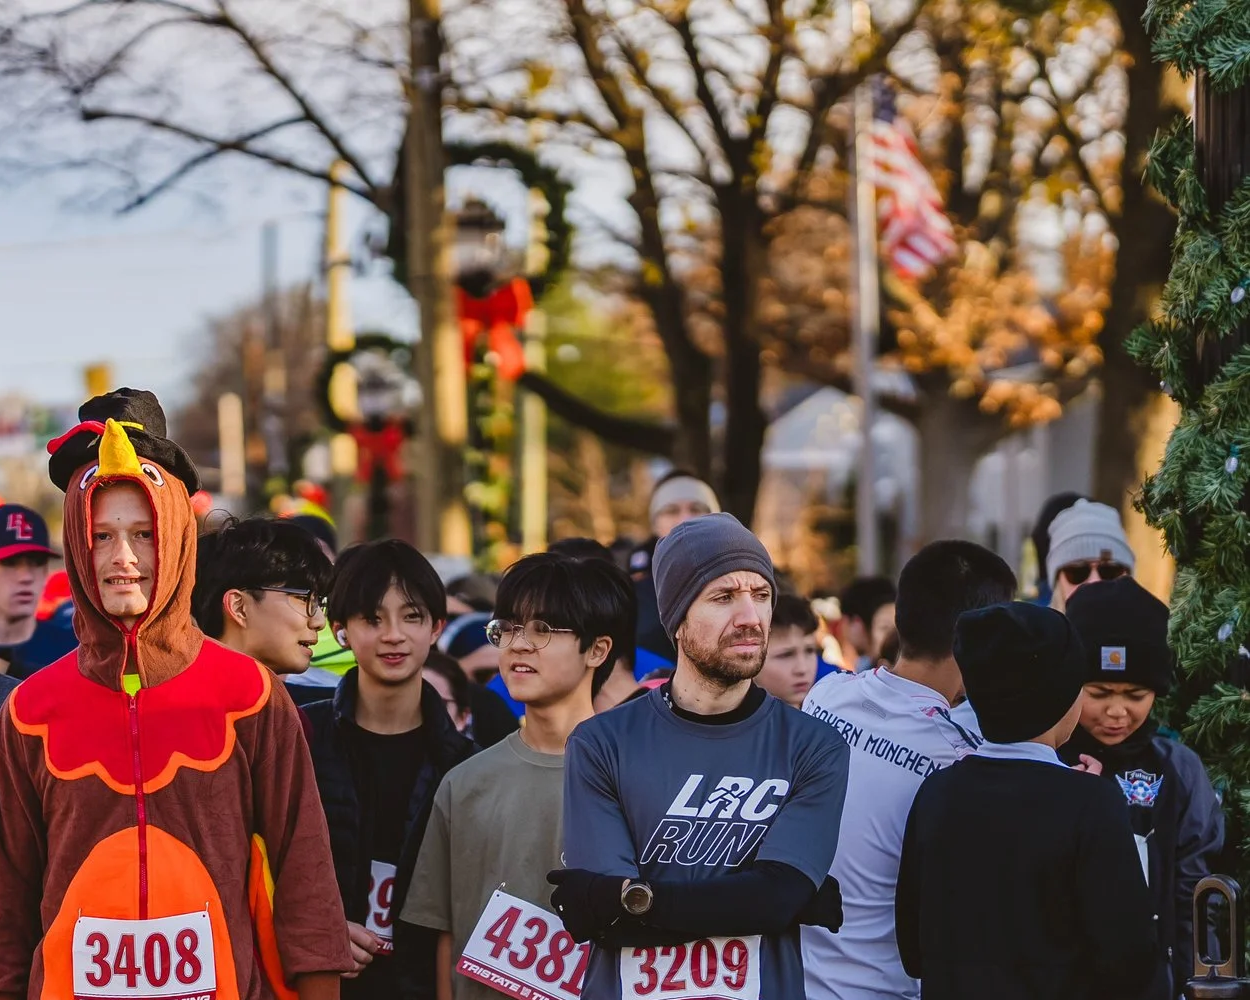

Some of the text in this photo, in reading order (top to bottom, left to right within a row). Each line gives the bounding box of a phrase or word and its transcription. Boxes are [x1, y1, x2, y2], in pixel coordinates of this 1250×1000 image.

[864, 734, 941, 778] MÜNCHEN
[665, 774, 789, 821] LRC
[640, 819, 768, 867] RUN
[85, 928, 202, 988] 3408
[484, 905, 591, 996] 4381
[632, 938, 750, 996] 3209
[461, 961, 519, 993] TRISTATE
